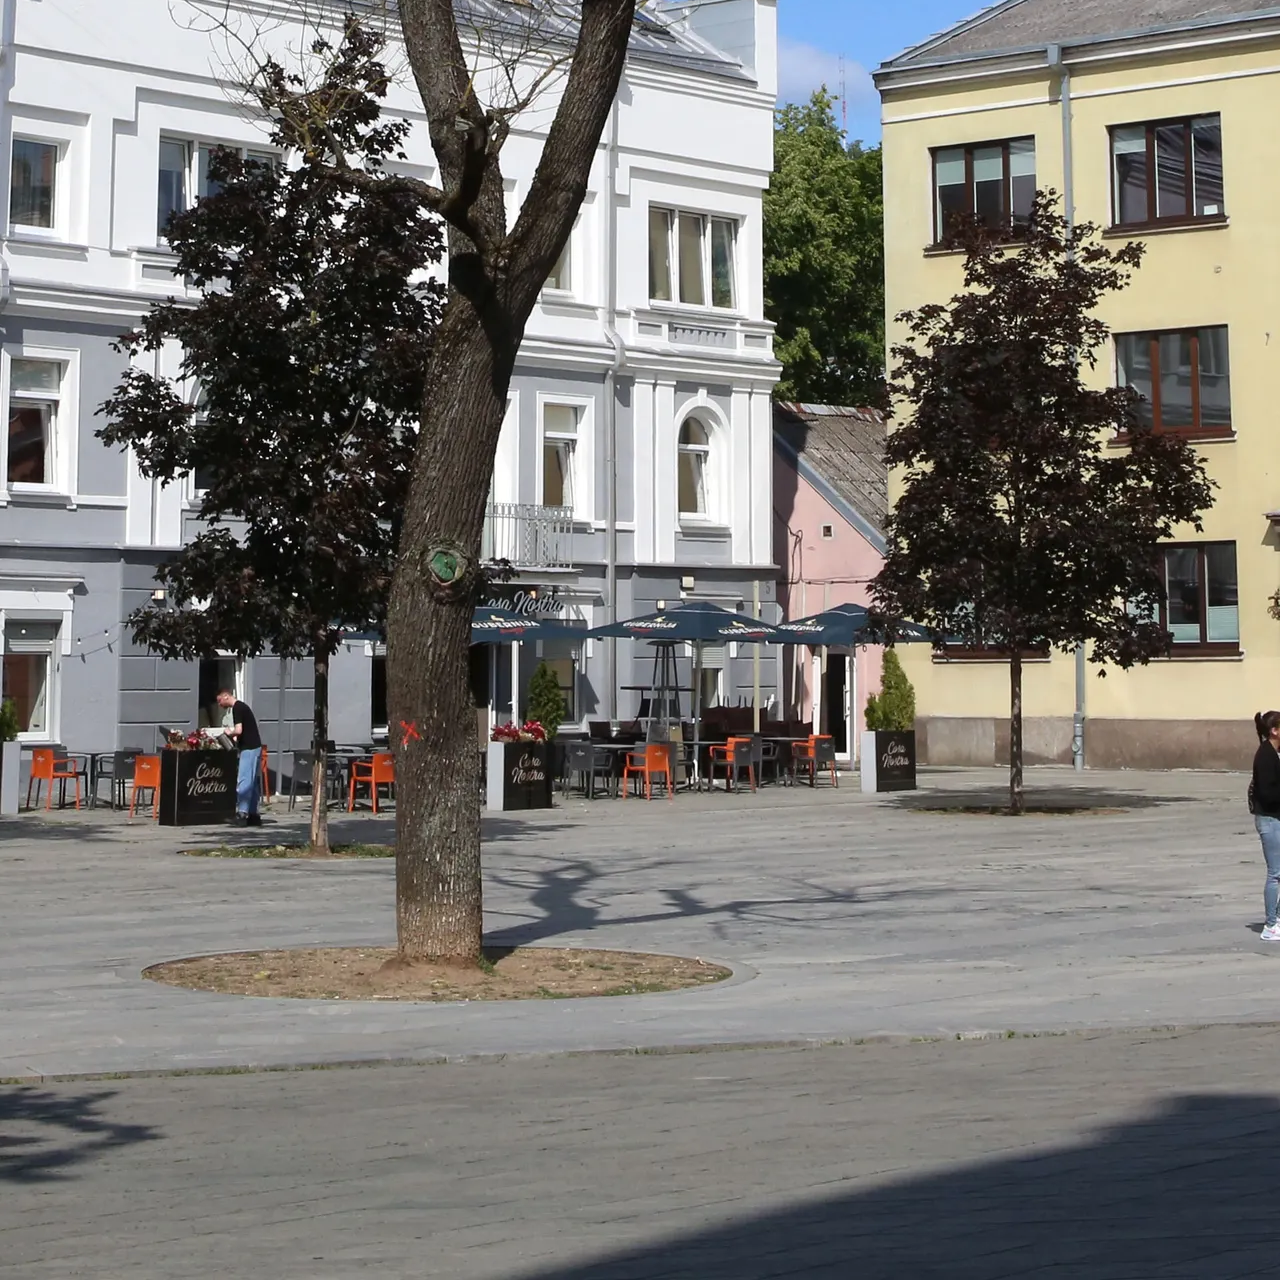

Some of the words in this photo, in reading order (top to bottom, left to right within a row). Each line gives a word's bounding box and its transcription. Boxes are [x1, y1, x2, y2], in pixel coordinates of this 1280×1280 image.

[514, 590, 564, 616] Nostra
[471, 620, 540, 629] GUBERNIJA
[196, 762, 223, 780] Cosa
[511, 767, 546, 784] Nostra
[186, 777, 228, 797] Nostra
